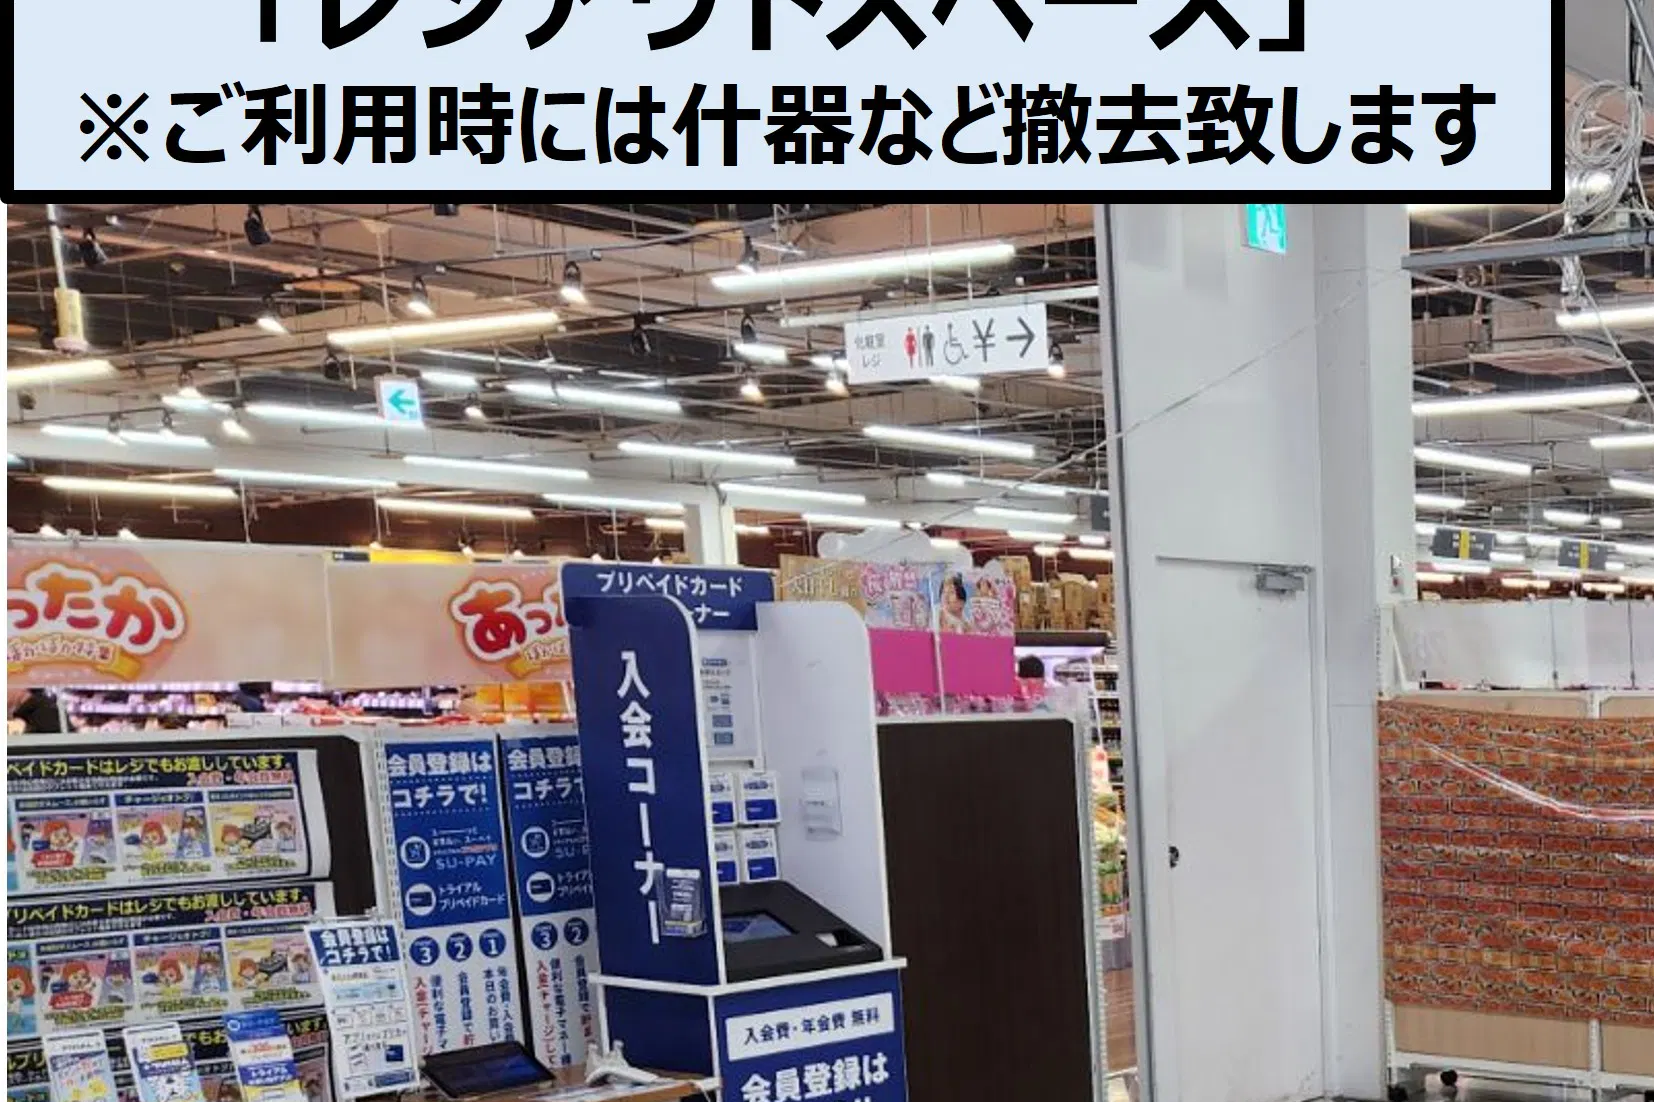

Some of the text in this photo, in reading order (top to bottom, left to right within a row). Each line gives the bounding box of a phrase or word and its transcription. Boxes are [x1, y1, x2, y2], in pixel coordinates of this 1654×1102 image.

[597, 570, 743, 598] プリペイドカード
[688, 602, 731, 624] ナー
[387, 751, 493, 778] 会員登録は
[616, 650, 666, 944] 入会コーナー
[436, 853, 497, 870] SU-PAY
[8, 889, 308, 924] リペイドカードはレジでもお渡ししています。
[571, 926, 582, 943] 2
[419, 947, 432, 964] 3
[453, 943, 466, 960] 2
[489, 938, 499, 956] 1
[744, 1007, 881, 1046] 入会費・年会費 無料
